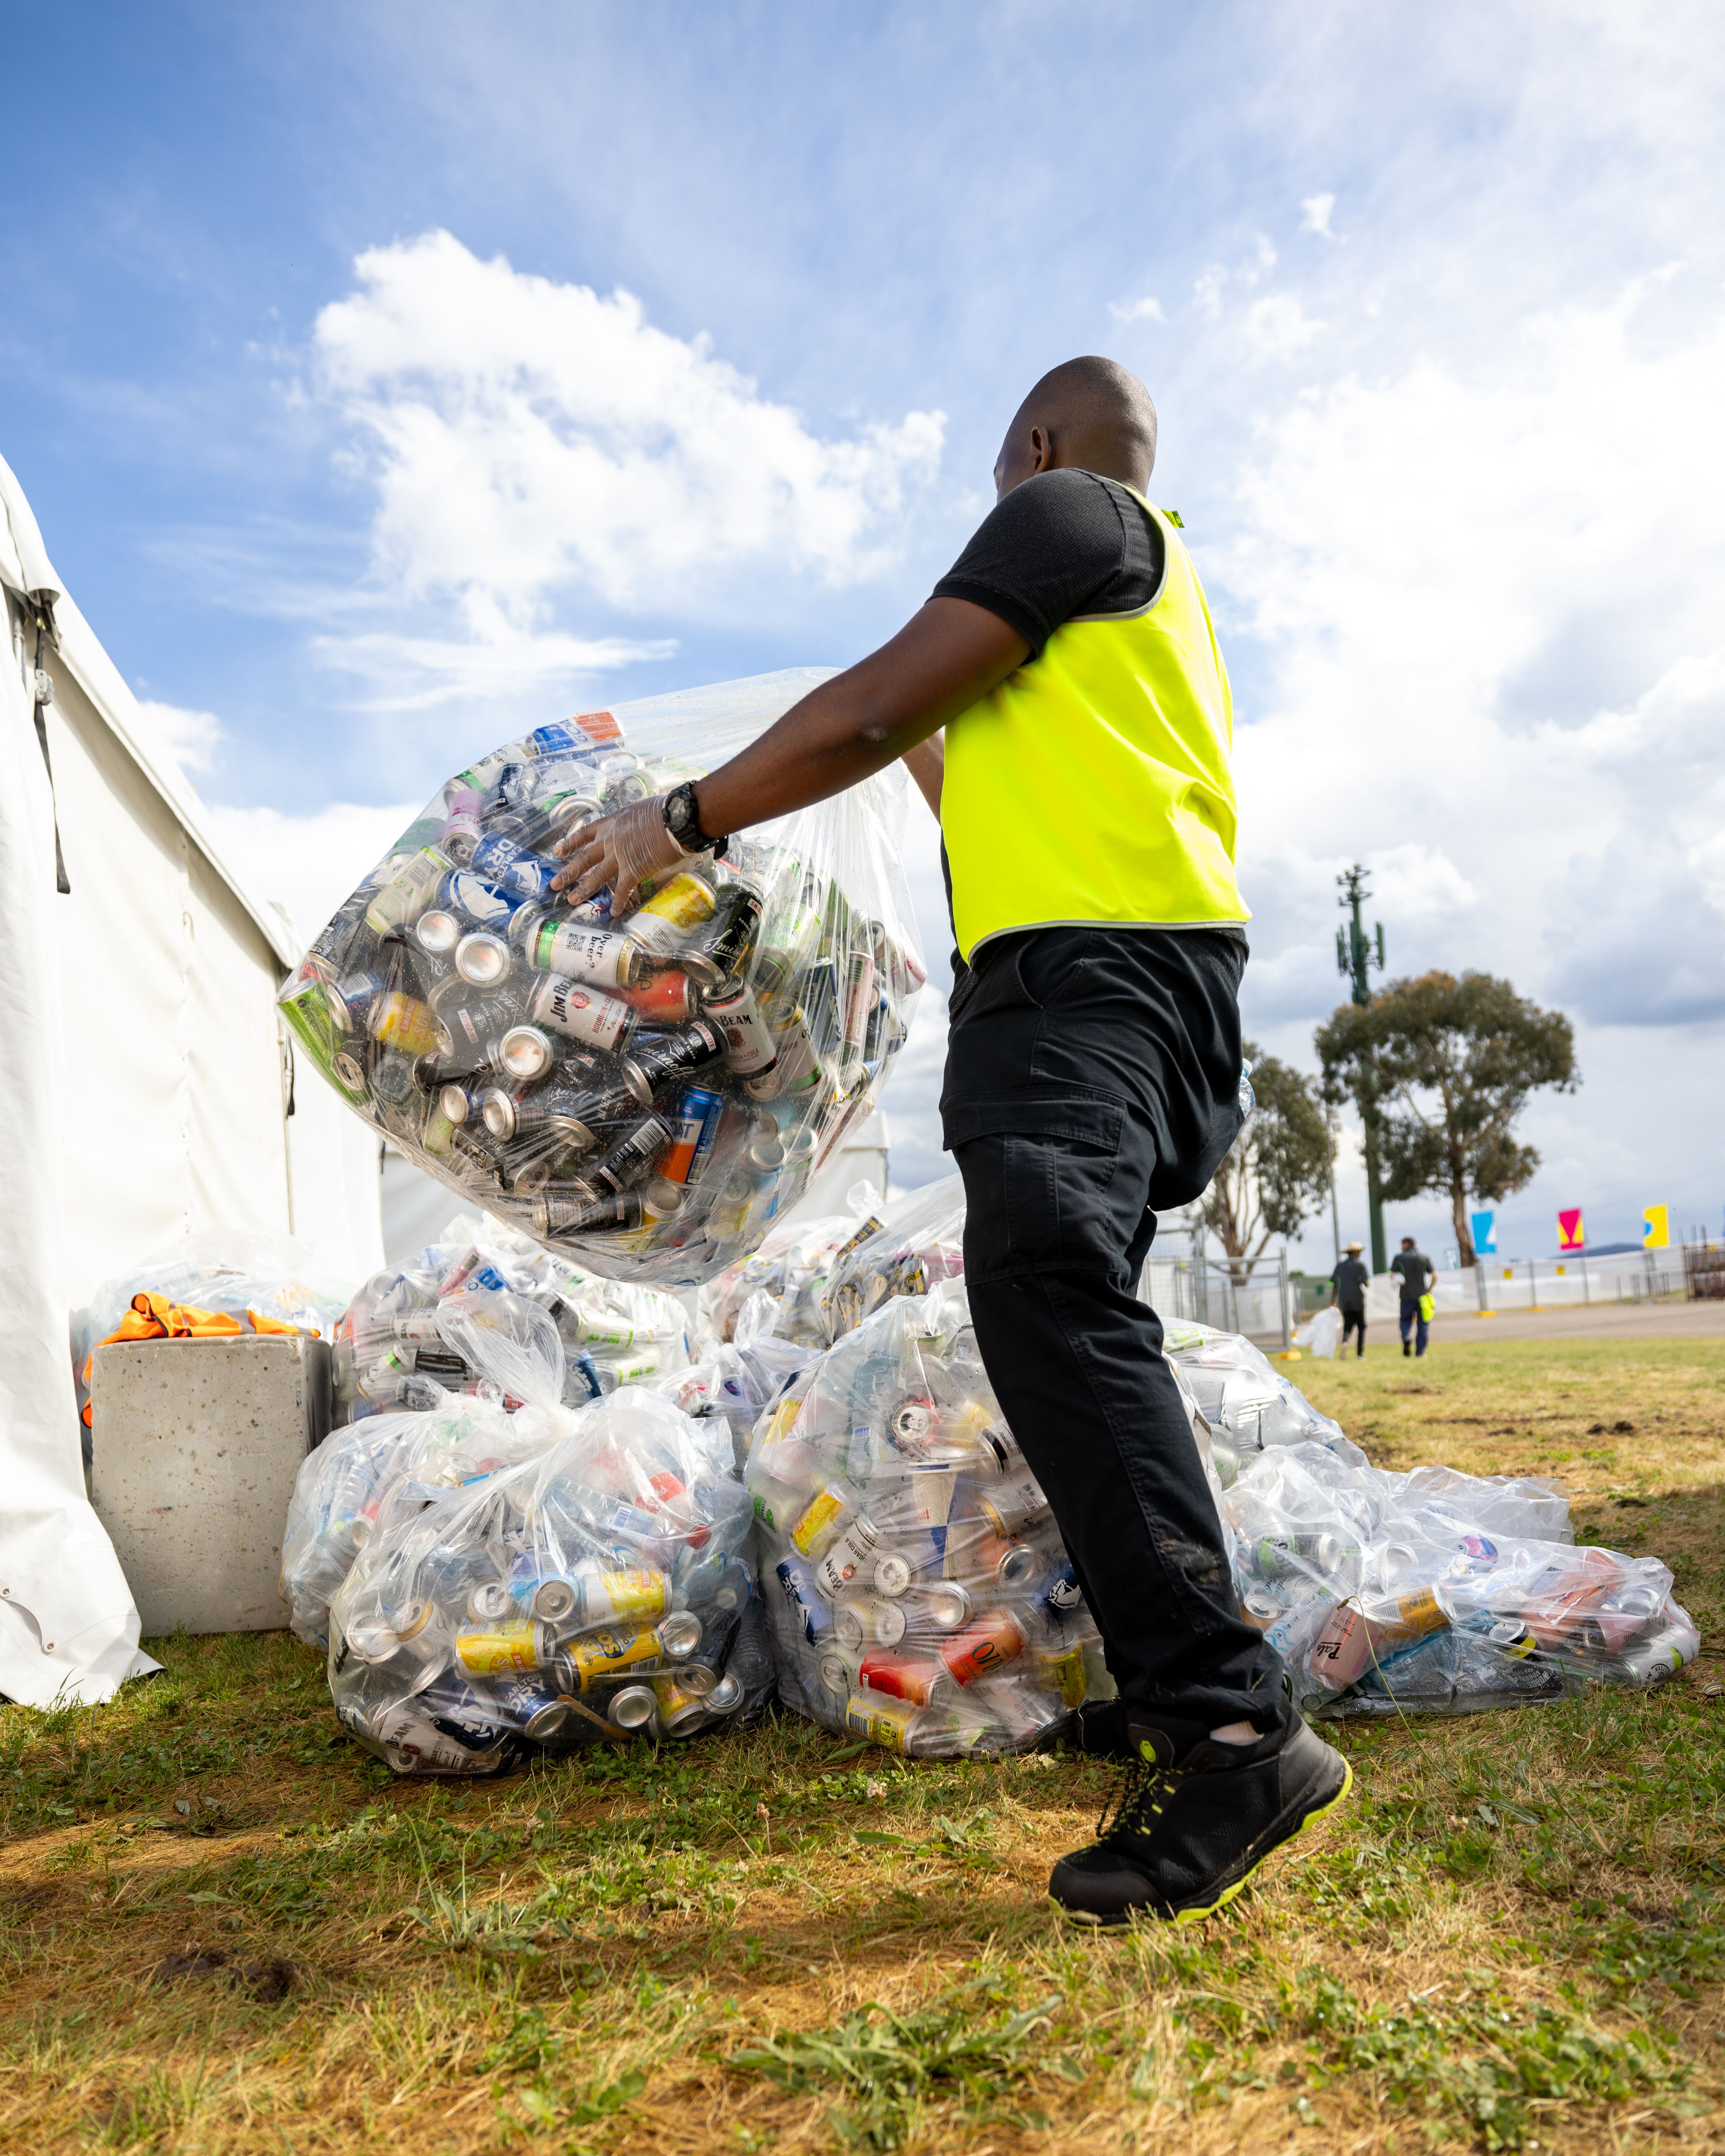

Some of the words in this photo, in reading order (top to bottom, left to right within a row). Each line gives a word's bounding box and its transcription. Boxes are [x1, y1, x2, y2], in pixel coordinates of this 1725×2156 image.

[484, 839, 515, 880] DRY
[750, 901, 762, 915] SMIR
[586, 936, 602, 969] beer?
[596, 933, 612, 958] Over
[553, 978, 576, 996] BEA
[550, 995, 568, 1023] JIM
[592, 1005, 608, 1034] BOURBON
[604, 995, 612, 1004] CO
[720, 1014, 753, 1027] BEAM
[460, 1012, 478, 1043] SMIRNOFF
[693, 1022, 715, 1048] SMIRNOFF
[675, 1033, 688, 1047] DOUBLE
[686, 1044, 696, 1060] BLACK
[747, 1048, 759, 1057] COLA
[400, 1321, 410, 1339] BEAM
[844, 1537, 857, 1551] COLA
[625, 1570, 635, 1586] DA
[782, 1568, 804, 1596] DR
[825, 1556, 844, 1592] BEAM
[593, 1630, 619, 1656] SO
[1316, 1645, 1341, 1660] Pals
[499, 1657, 511, 1675] SO
[505, 1673, 541, 1703] CARLTON
[510, 1679, 547, 1712] DRY
[385, 1722, 416, 1750] BEAM
